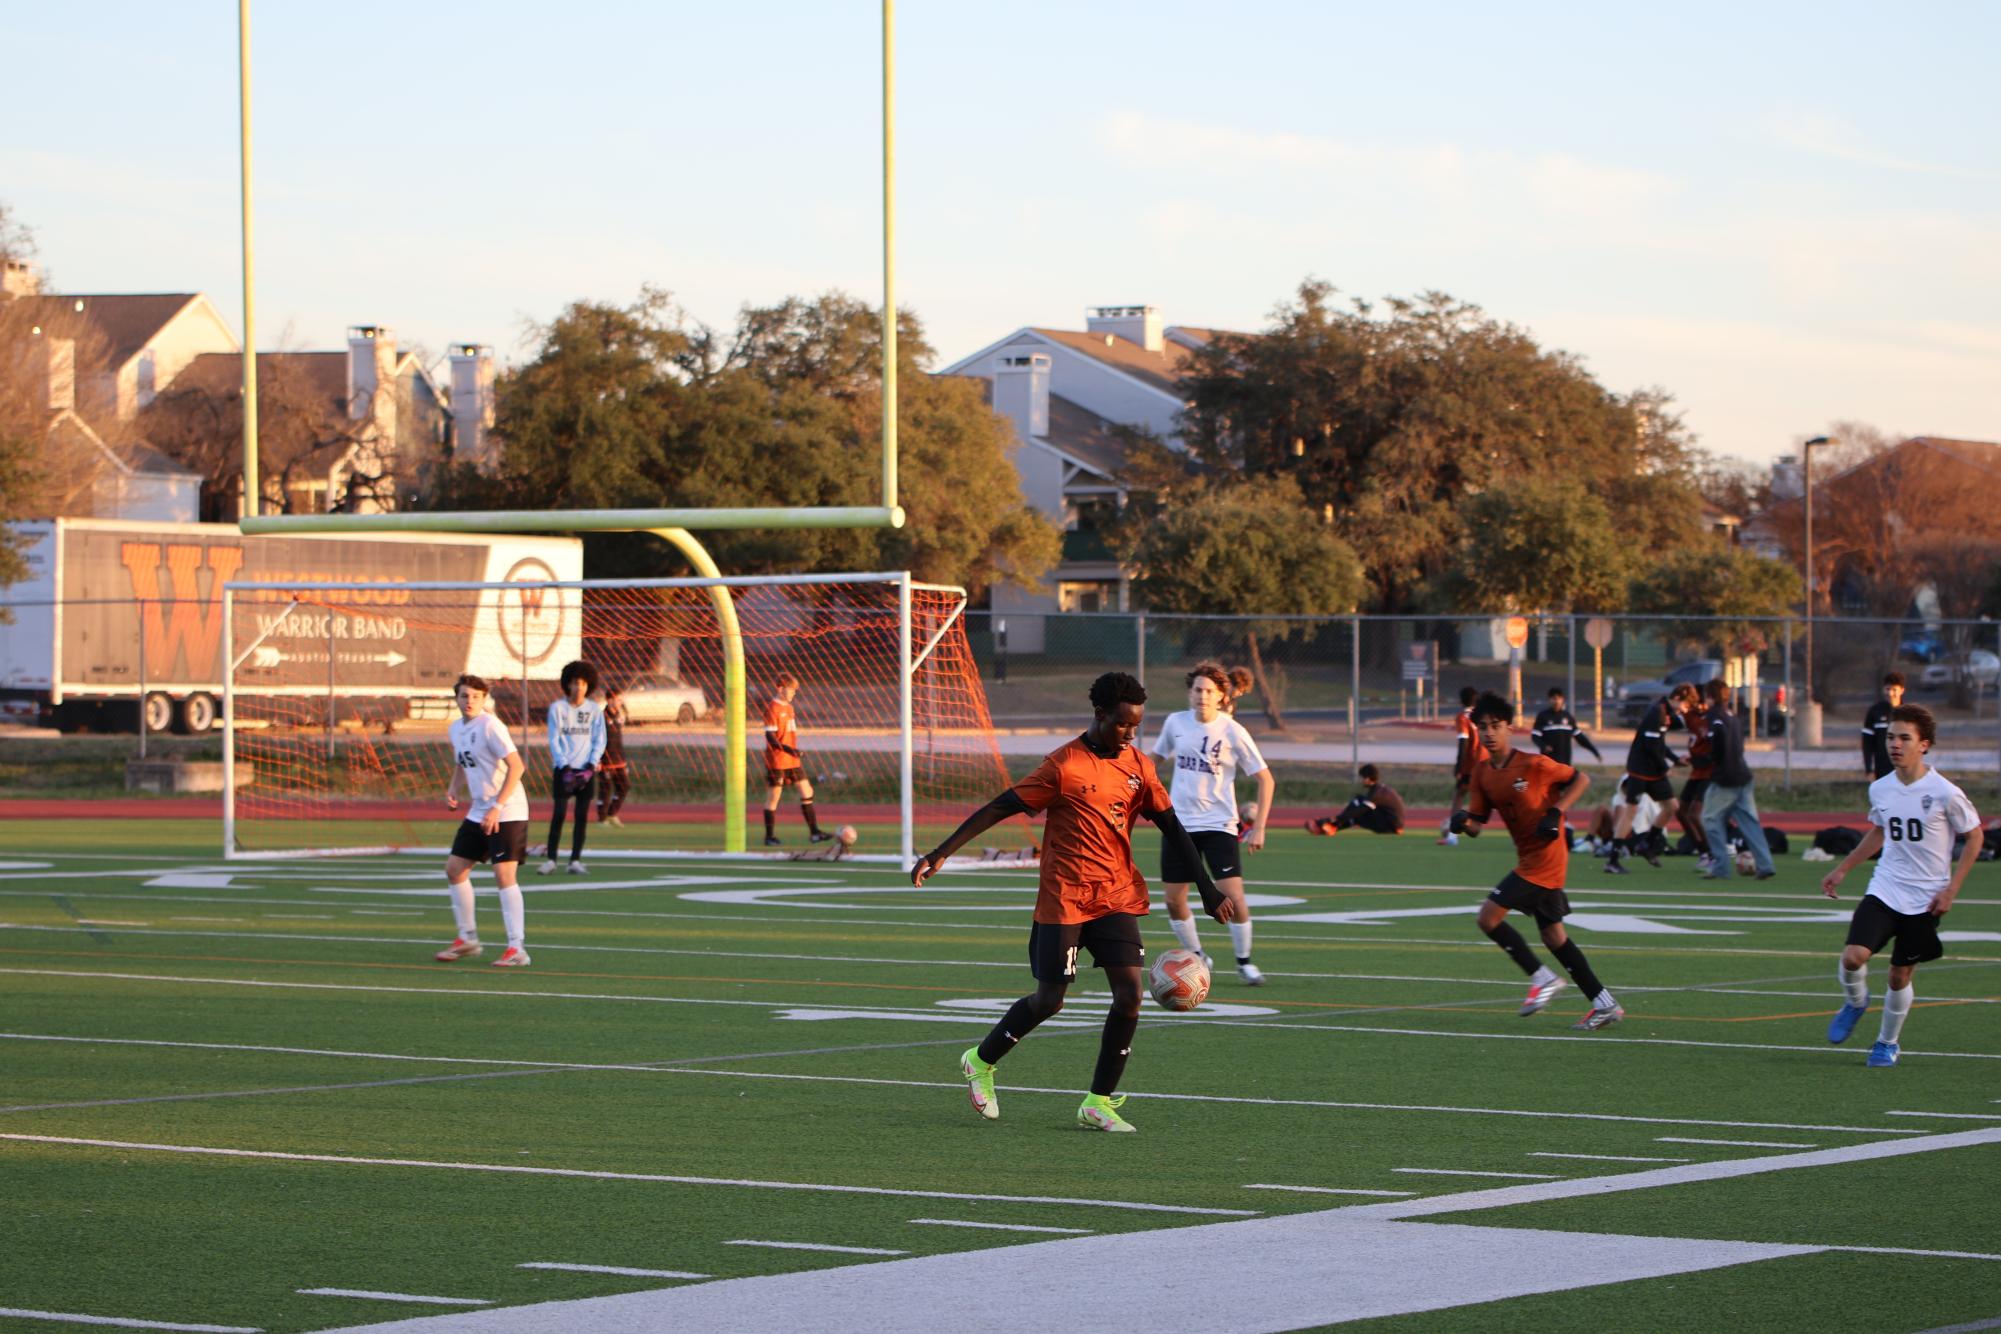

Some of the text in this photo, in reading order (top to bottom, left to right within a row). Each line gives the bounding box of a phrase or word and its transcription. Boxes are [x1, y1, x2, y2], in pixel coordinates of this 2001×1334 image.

[121, 543, 243, 681] W
[256, 614, 406, 640] WARRIOR BAND
[1201, 735, 1222, 758] 14
[1889, 816, 1923, 842] 60
